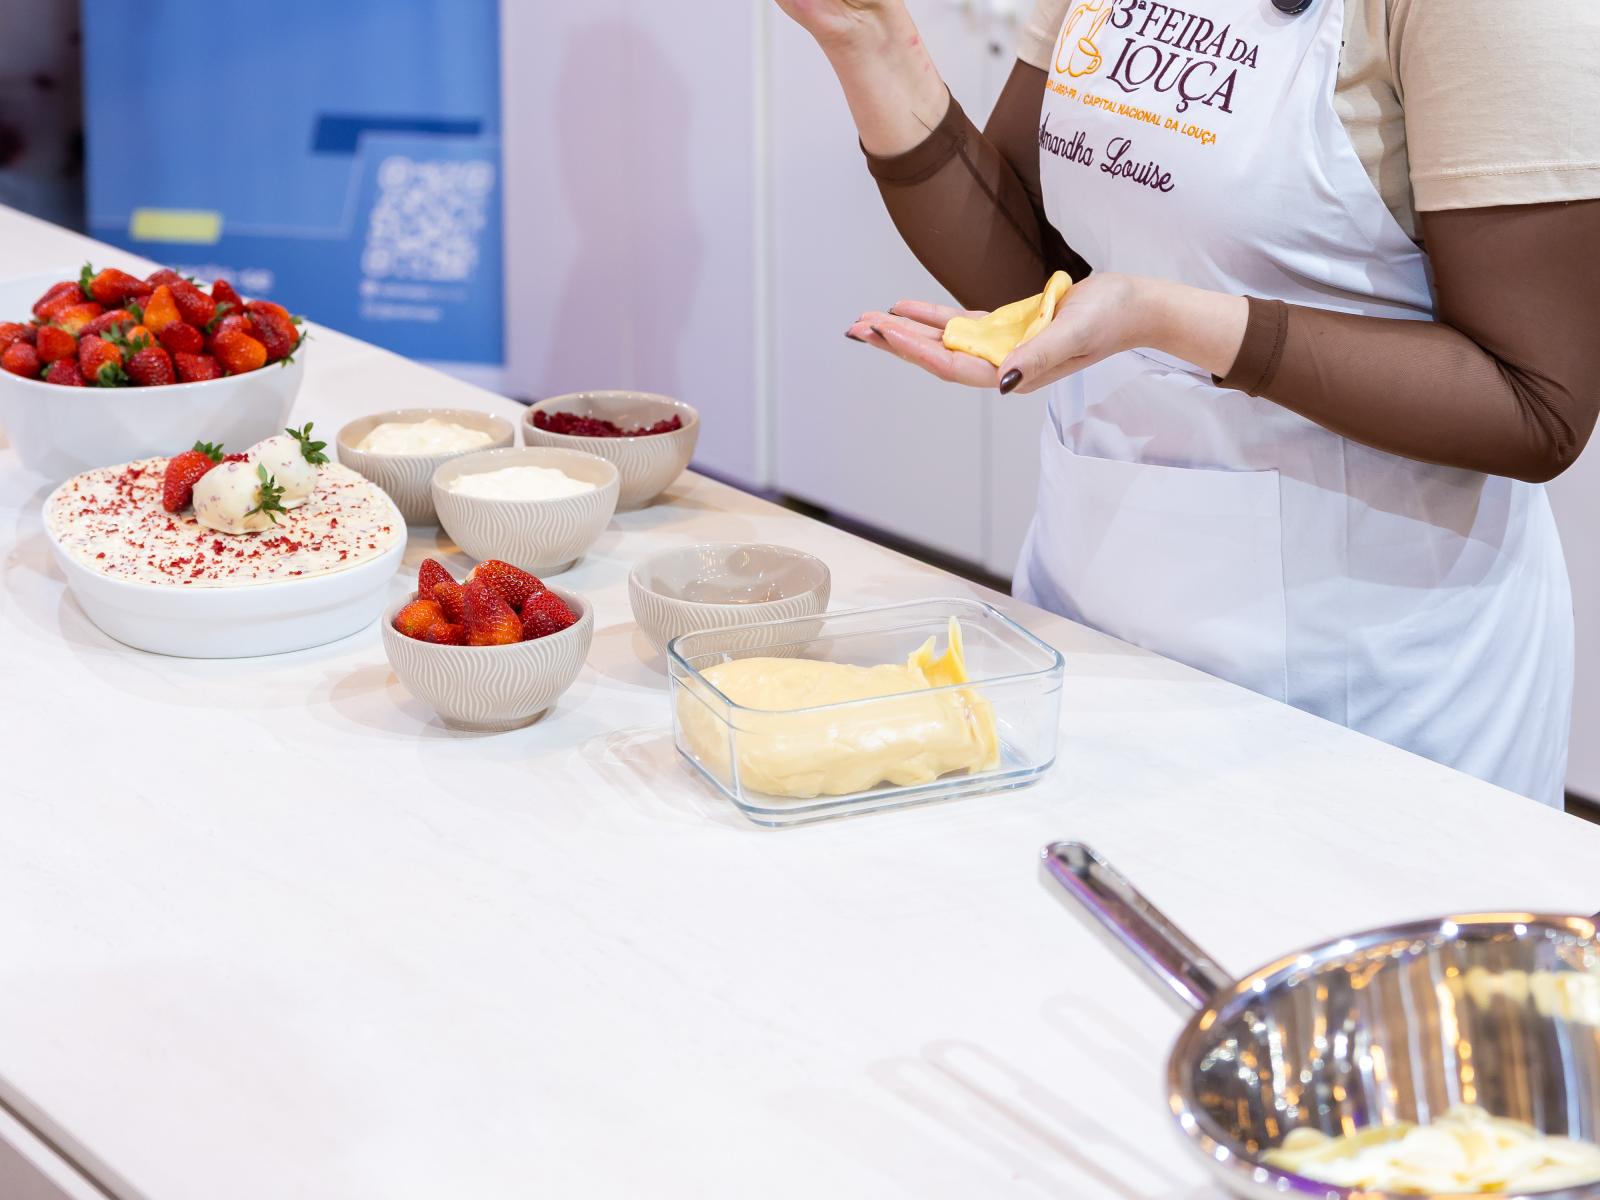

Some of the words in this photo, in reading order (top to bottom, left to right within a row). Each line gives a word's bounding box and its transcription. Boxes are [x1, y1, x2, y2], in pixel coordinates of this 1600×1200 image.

[1135, 1, 1231, 58] FEIRA
[1226, 38, 1259, 69] DA
[1106, 37, 1238, 114] LOUÇA
[1083, 93, 1118, 113] CAPITAL
[1116, 103, 1161, 126] NACIONAL
[1164, 118, 1179, 132] DA
[1181, 123, 1217, 145] LOUÇA
[1100, 137, 1175, 193] Louise
